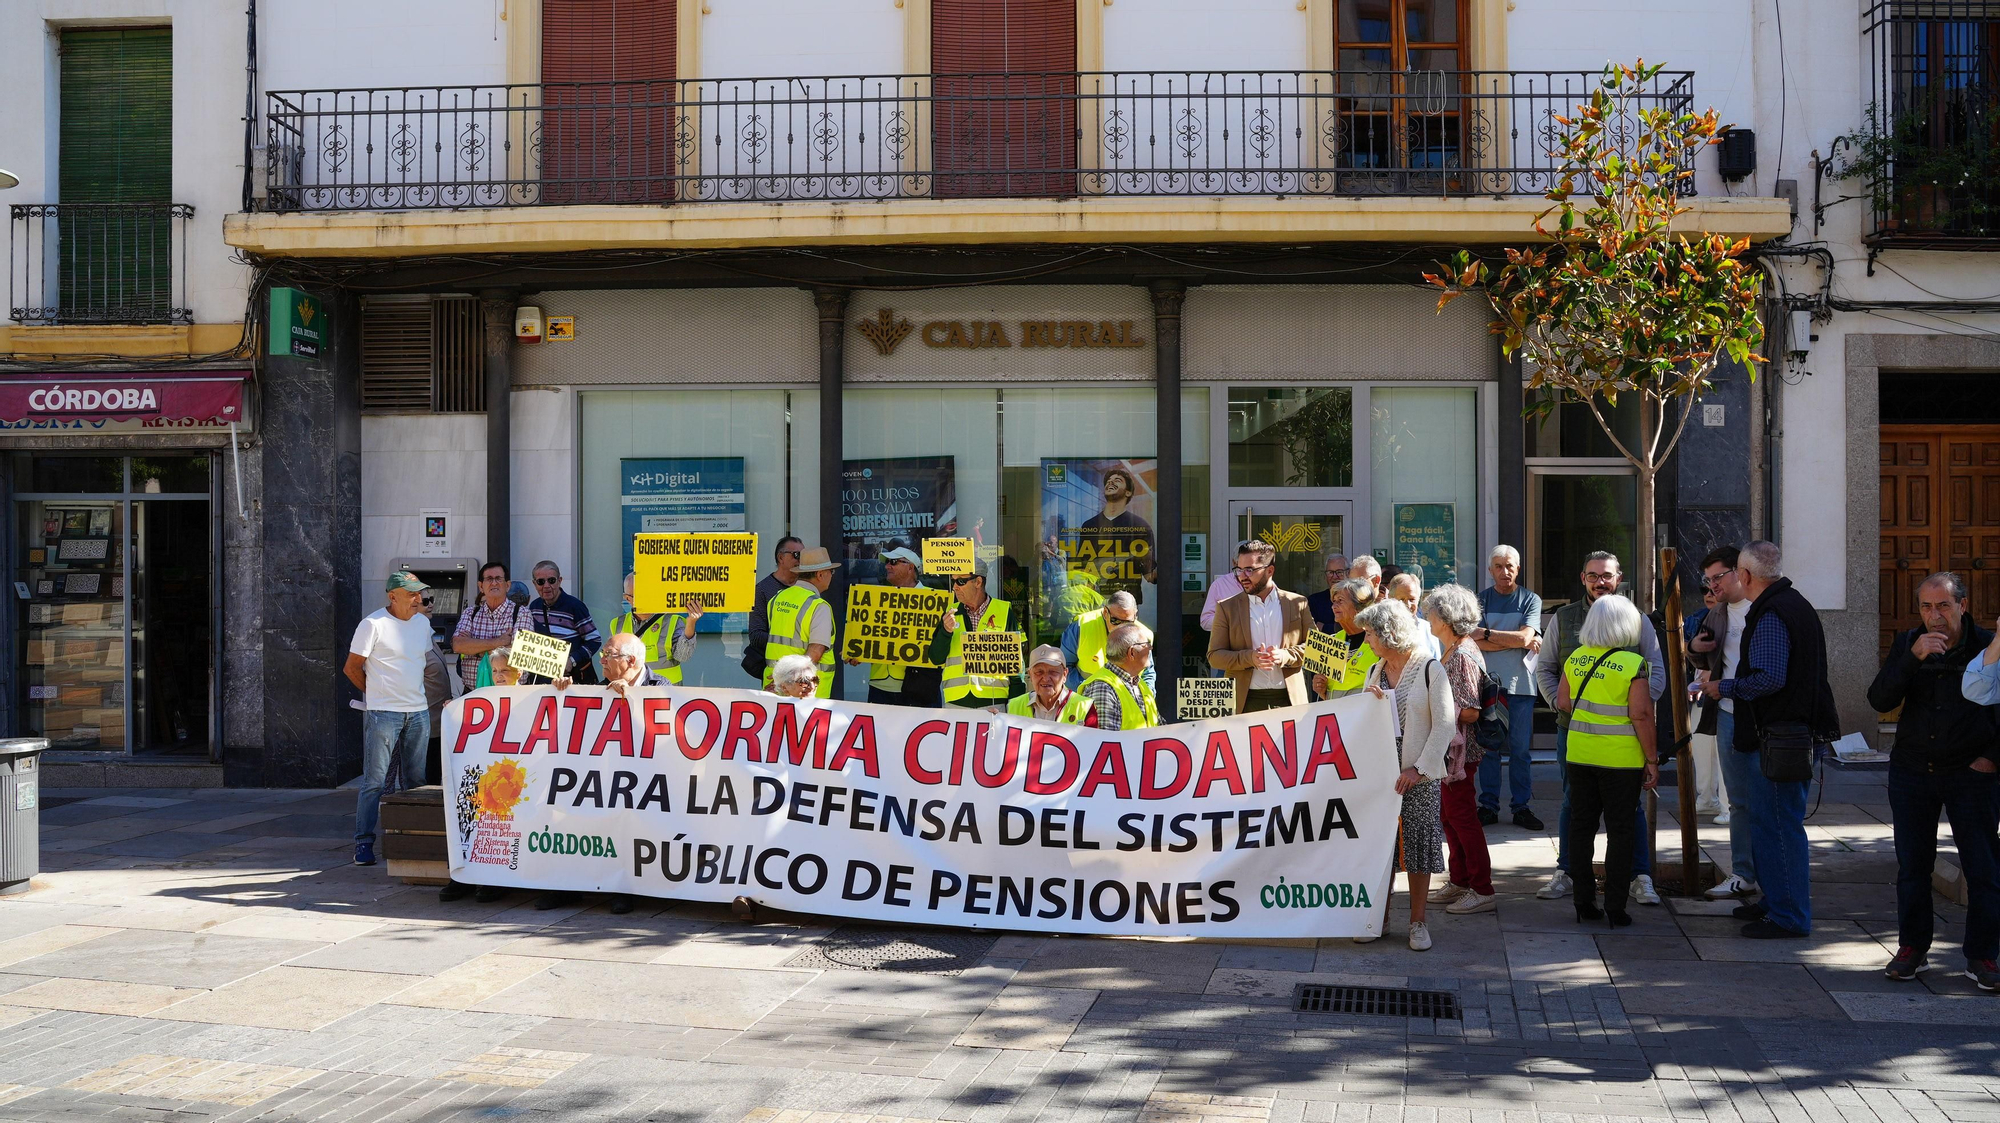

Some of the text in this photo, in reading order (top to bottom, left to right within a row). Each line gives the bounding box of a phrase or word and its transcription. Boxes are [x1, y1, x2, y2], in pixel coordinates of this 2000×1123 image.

[292, 326, 319, 340] CAJA RURAL
[922, 321, 1145, 349] CAJA RURAL
[28, 385, 157, 411] CÓRDOBA
[1705, 408, 1722, 424] 14
[631, 472, 700, 487] Kit Digital
[842, 487, 920, 501] 100 EUROS
[842, 501, 913, 515] POR CADA
[842, 513, 934, 530] SOBRESALIENTE
[1400, 526, 1422, 535] Paga
[638, 539, 754, 555] GOBIERNE QUIEN GOBIERNE
[1059, 539, 1149, 558] HAZLO
[662, 566, 729, 581] LAS PENSIONES
[666, 593, 676, 608] SE
[852, 590, 949, 611] LA PENSIÓN
[851, 608, 940, 628] NO SE DEFIEND
[861, 625, 932, 641] DESDE EL
[1309, 630, 1346, 651] PENSIONES
[517, 631, 567, 652] PENSIONES
[963, 644, 1019, 652] PENSIONES
[522, 645, 558, 660] EN LOS
[510, 651, 562, 678] PRESUPUESTOS
[965, 662, 1020, 674] MILLONES
[1304, 657, 1330, 677] PRIVADAS
[1332, 668, 1341, 681] NO
[1570, 655, 1624, 671] ay@Flutas
[1179, 680, 1190, 688] LA
[453, 696, 1357, 800] PLATAFORMA CIUDADANA
[479, 811, 514, 821] Plataforma
[546, 768, 1359, 852] PARA LA DEFENSA DEL SISTEMA
[478, 820, 511, 830] Ciudadana
[477, 830, 492, 839] para
[499, 829, 521, 837] Defensa
[485, 837, 509, 846] Sistema
[528, 825, 618, 858] CÓRDOBA
[473, 844, 510, 855] Público de
[469, 851, 509, 865] Pensiones
[633, 834, 1240, 925] PÚBLICO DE PENSIONES
[1260, 876, 1372, 908] CÓRDOBA
